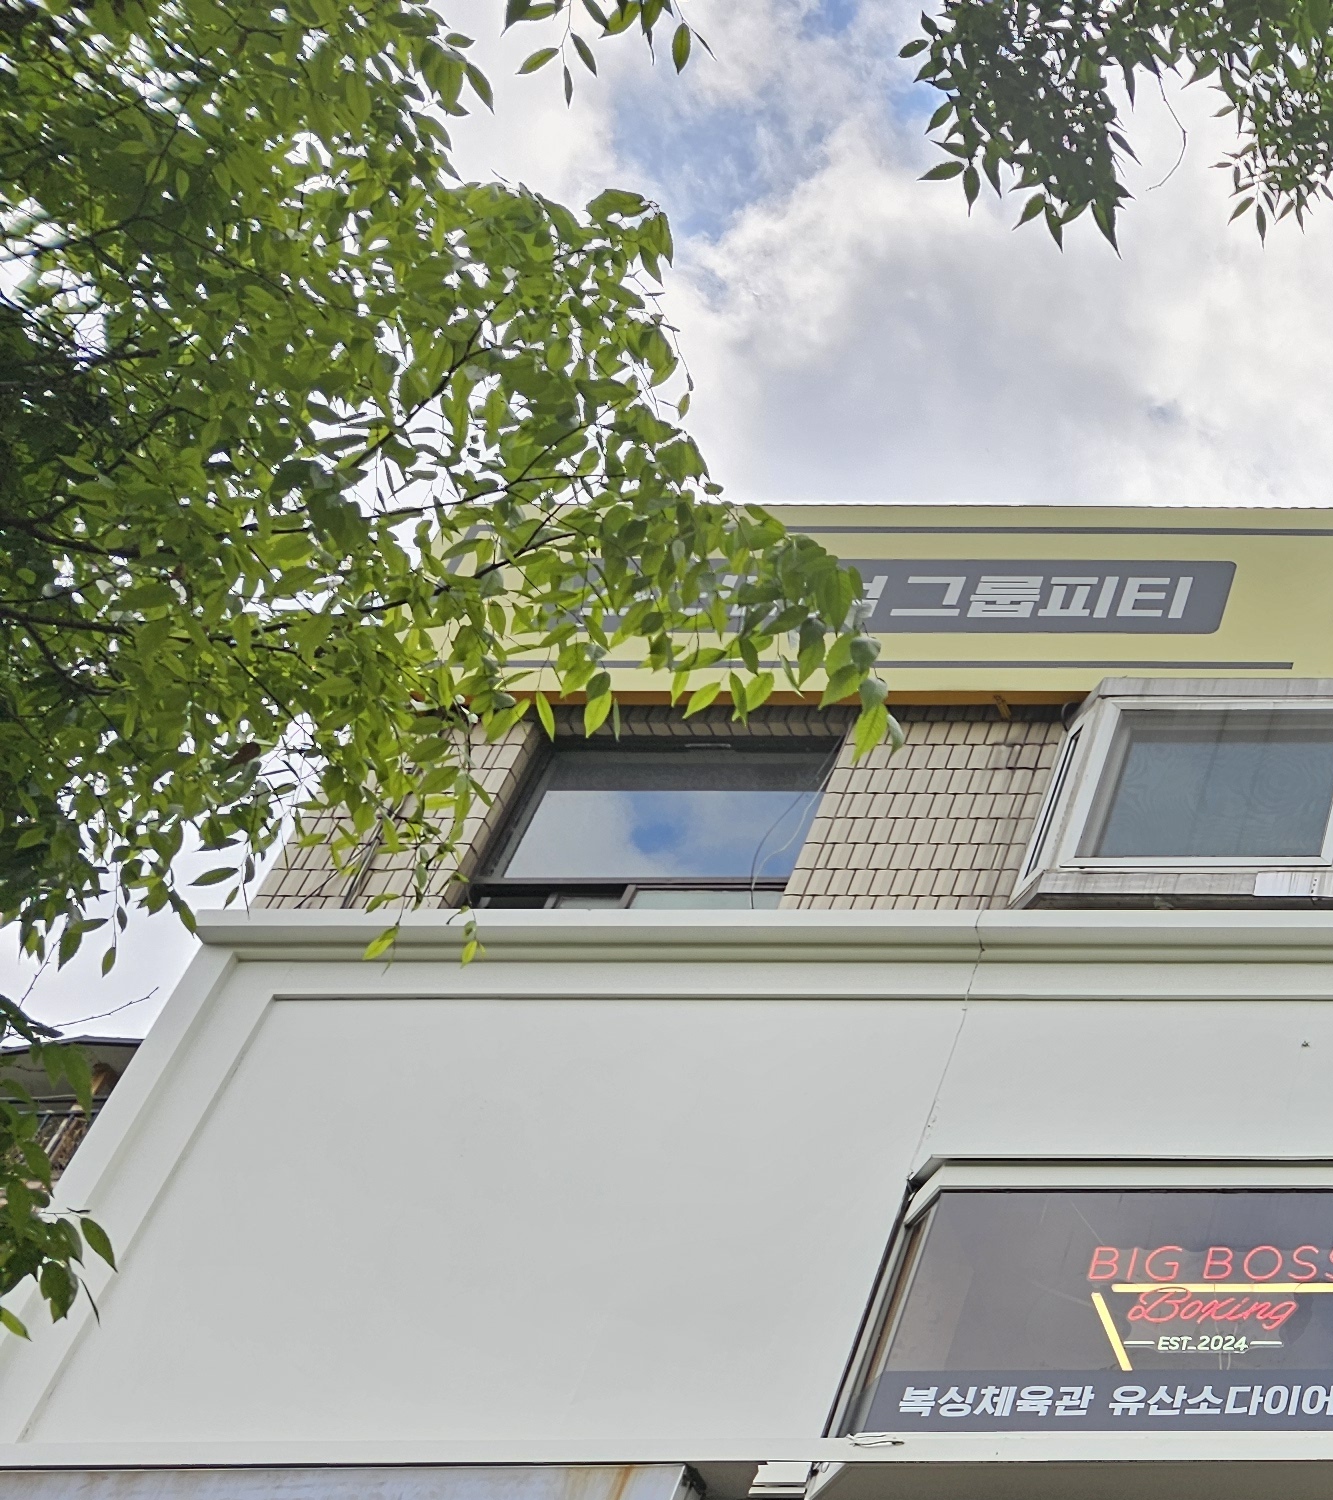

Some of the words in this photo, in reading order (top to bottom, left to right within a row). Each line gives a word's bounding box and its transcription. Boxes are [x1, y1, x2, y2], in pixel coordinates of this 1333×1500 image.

[1087, 1245, 1183, 1281] BIG
[1127, 1287, 1298, 1330] Boxing
[899, 1385, 1094, 1417] 복싱체육관
